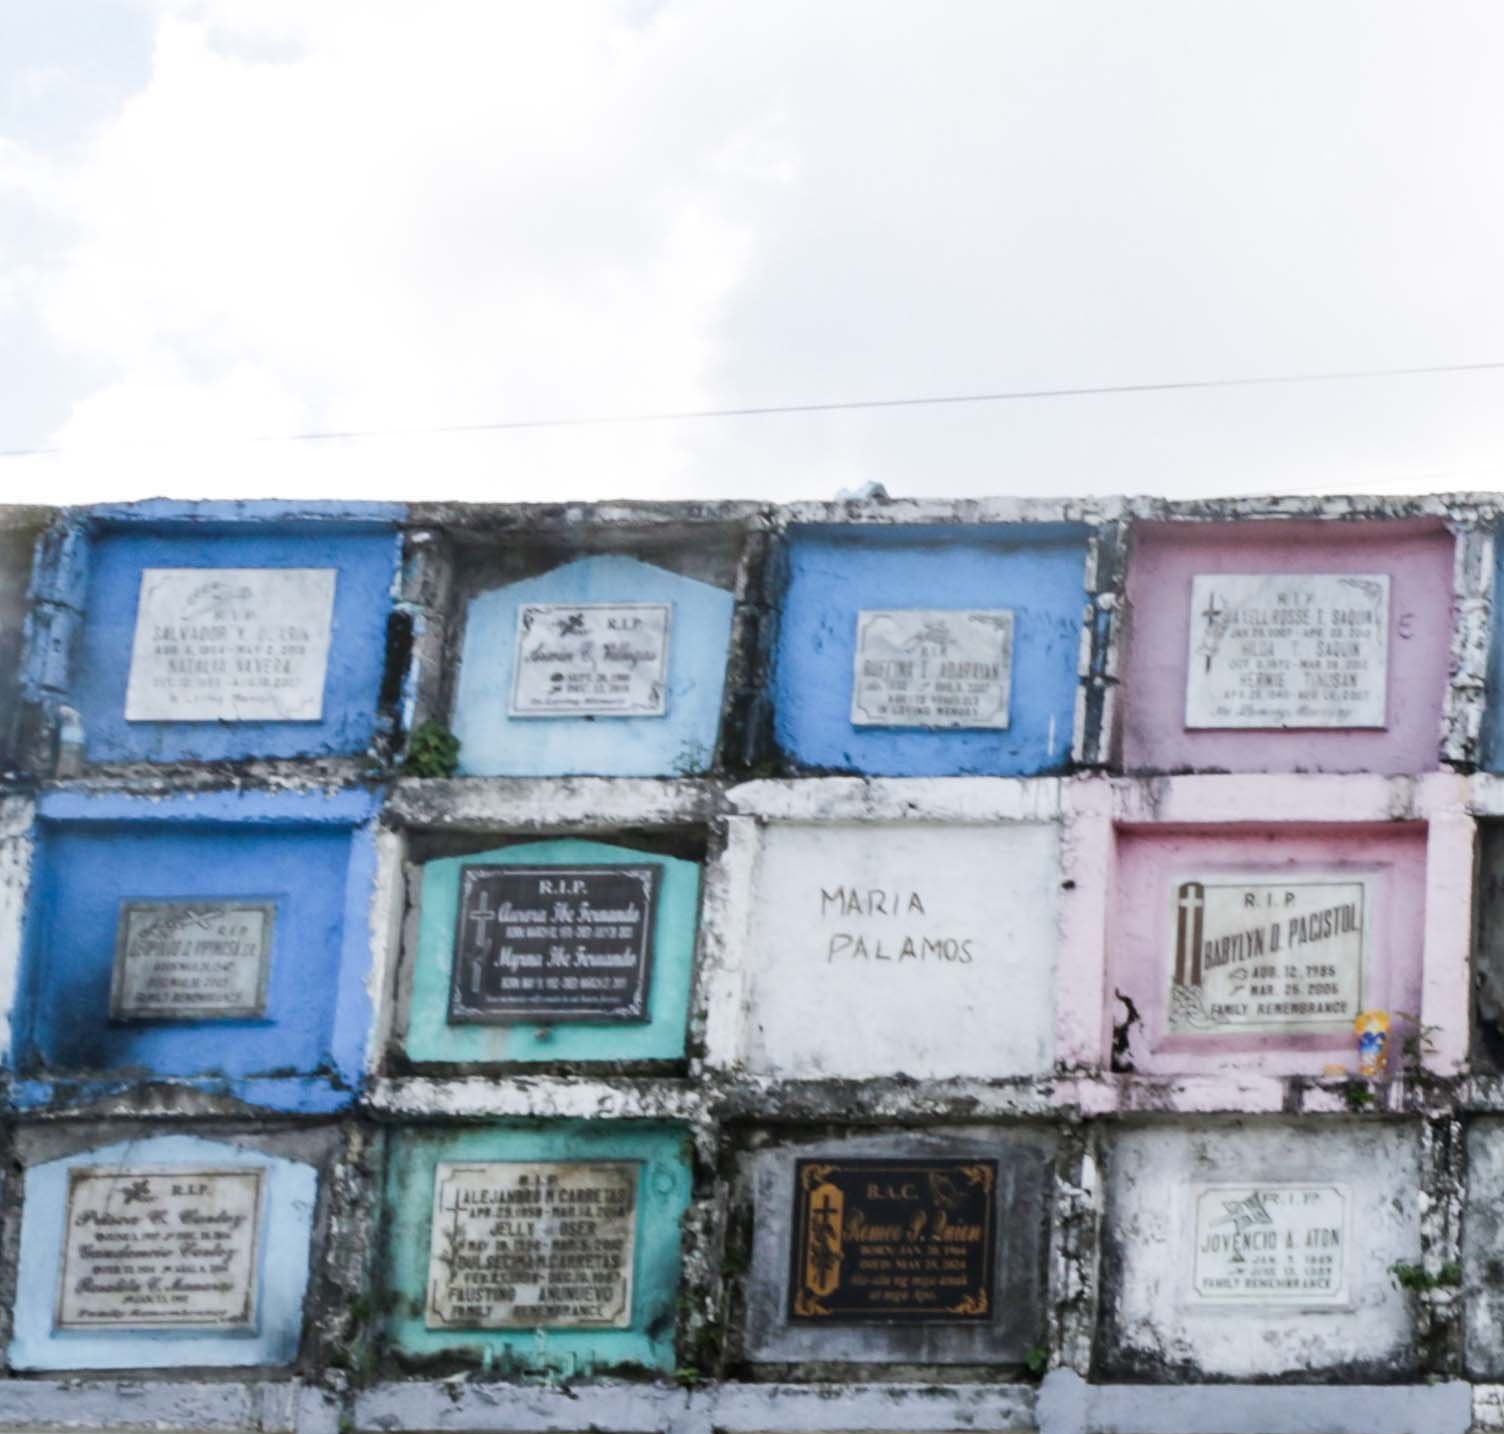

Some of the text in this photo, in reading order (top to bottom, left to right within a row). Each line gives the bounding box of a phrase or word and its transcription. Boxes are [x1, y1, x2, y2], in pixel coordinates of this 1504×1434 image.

[539, 880, 589, 895] R.I.P.
[821, 885, 927, 918] MARIA
[828, 933, 976, 965] PALAMOS
[1211, 1002, 1349, 1016] FAMILY REMEMBRANCE
